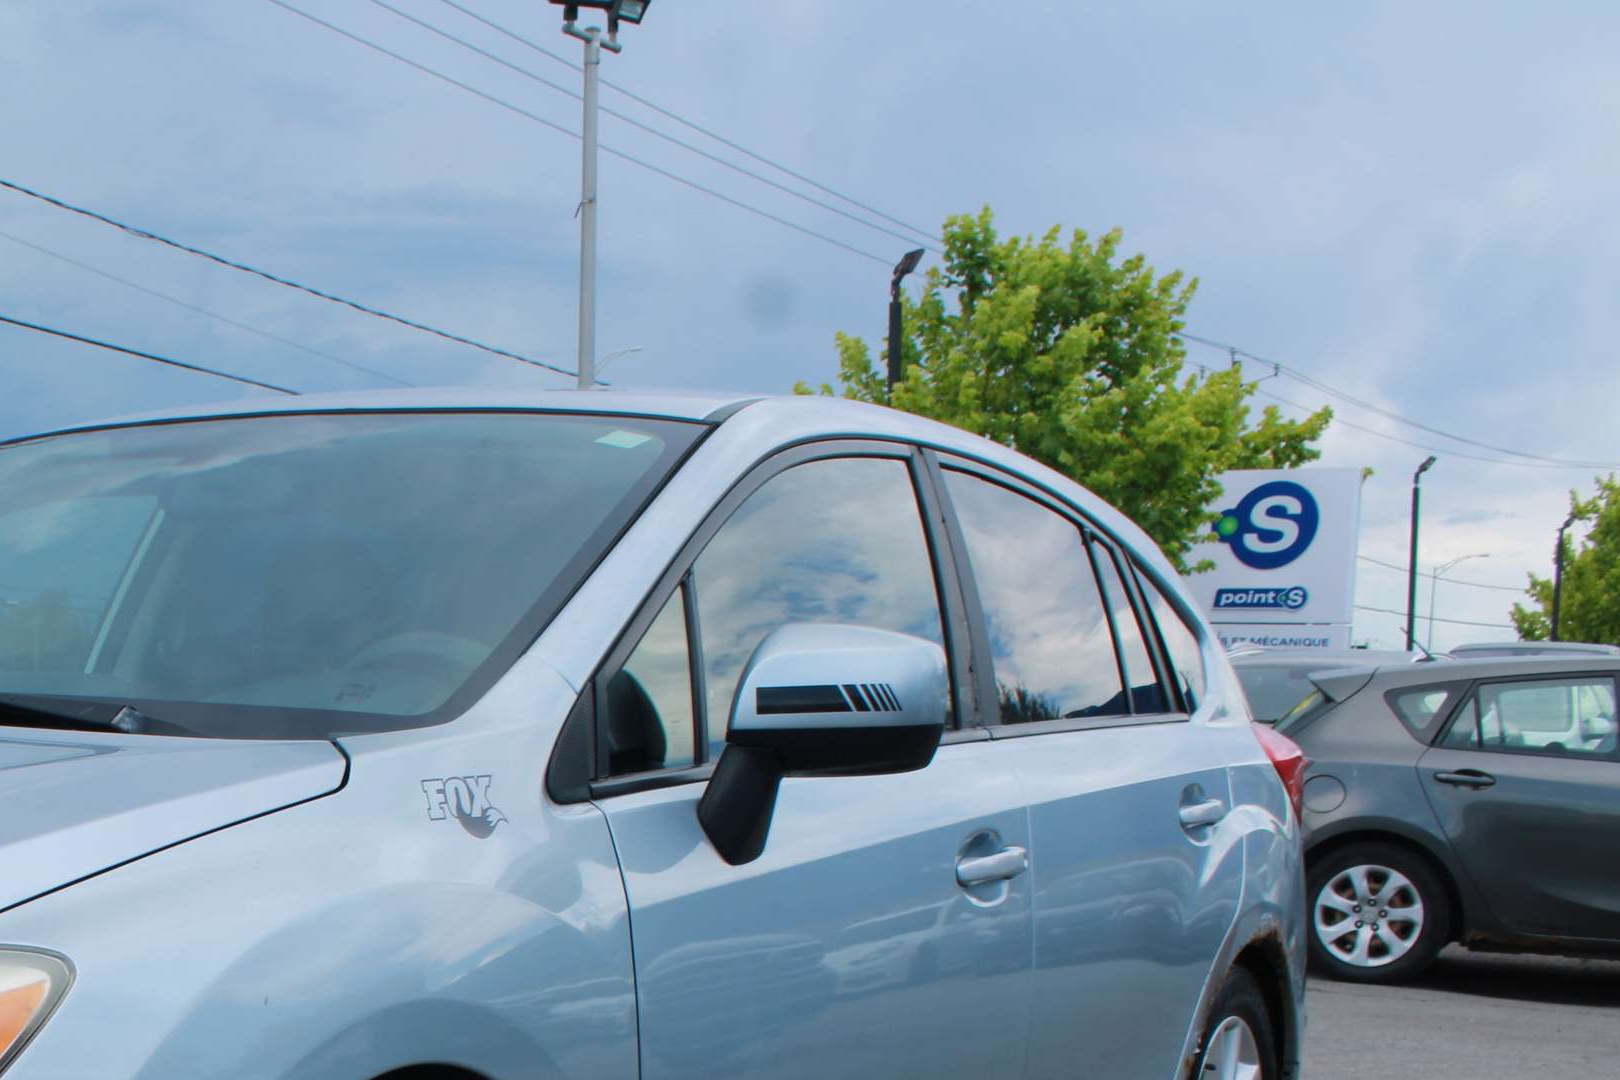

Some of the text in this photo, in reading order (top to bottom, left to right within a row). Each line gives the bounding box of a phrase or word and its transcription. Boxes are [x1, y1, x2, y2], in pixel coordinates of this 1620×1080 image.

[1243, 495, 1302, 553] S
[1220, 589, 1304, 606] point S
[1250, 636, 1329, 647] MÉCANIQUE
[421, 774, 504, 832] FOX
